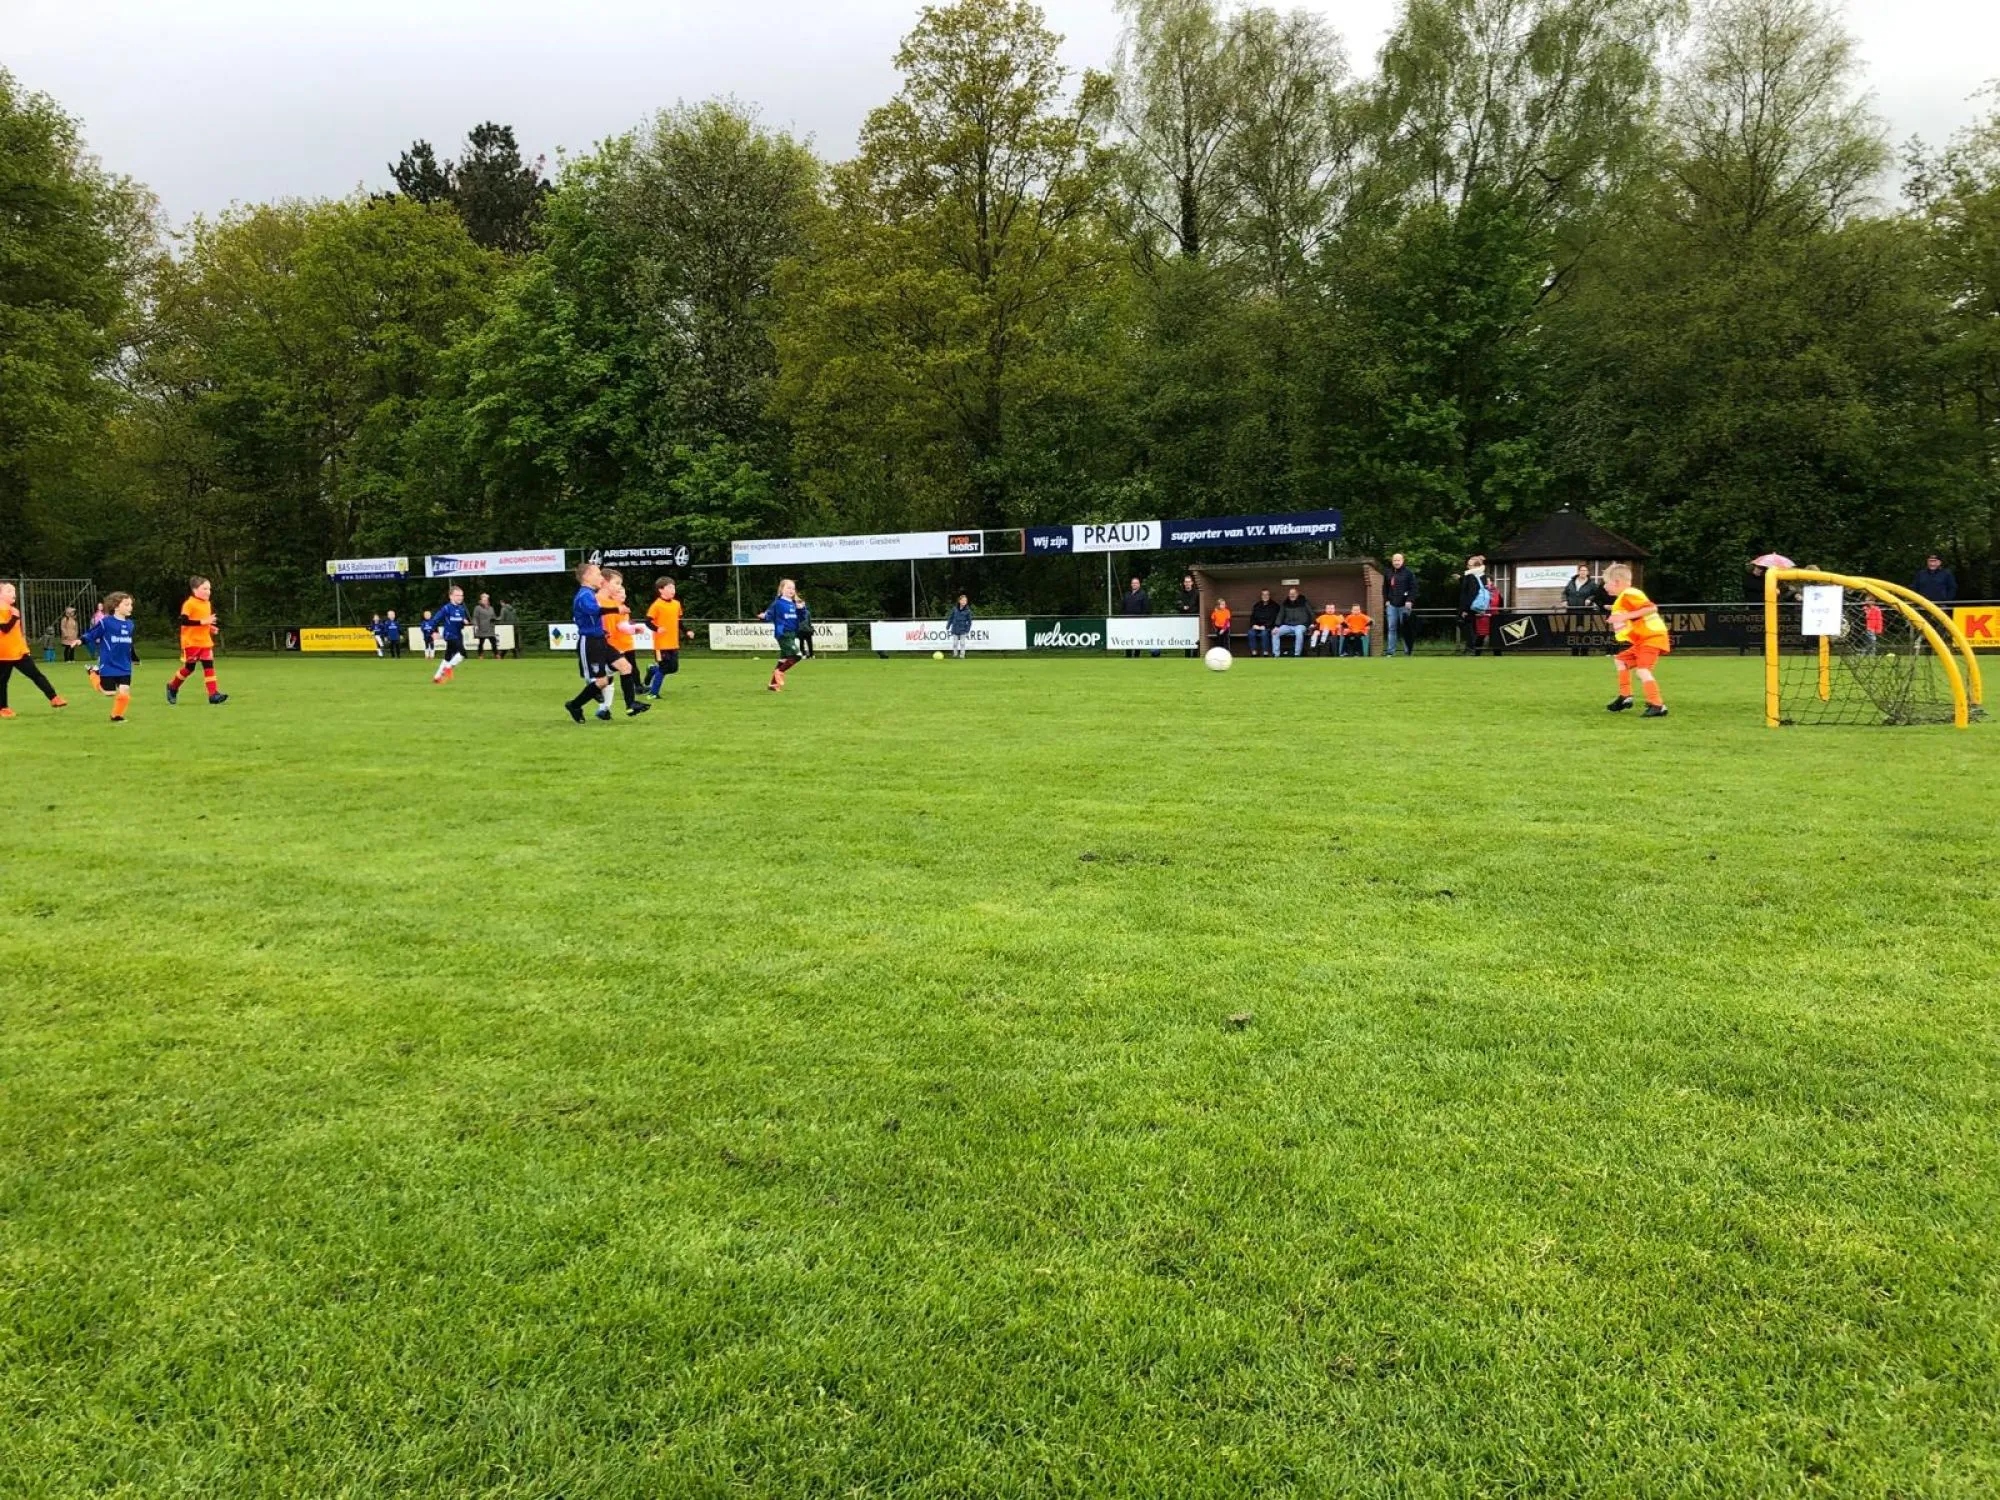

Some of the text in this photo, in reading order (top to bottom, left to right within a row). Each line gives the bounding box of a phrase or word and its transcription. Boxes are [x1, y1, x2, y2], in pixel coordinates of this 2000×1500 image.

[1033, 522, 1336, 549] Wij zijn PRAUD supporter van V.V. Witkampers
[1111, 637, 1135, 646] Weet
[1137, 638, 1154, 646] wat
[1156, 637, 1166, 646] te
